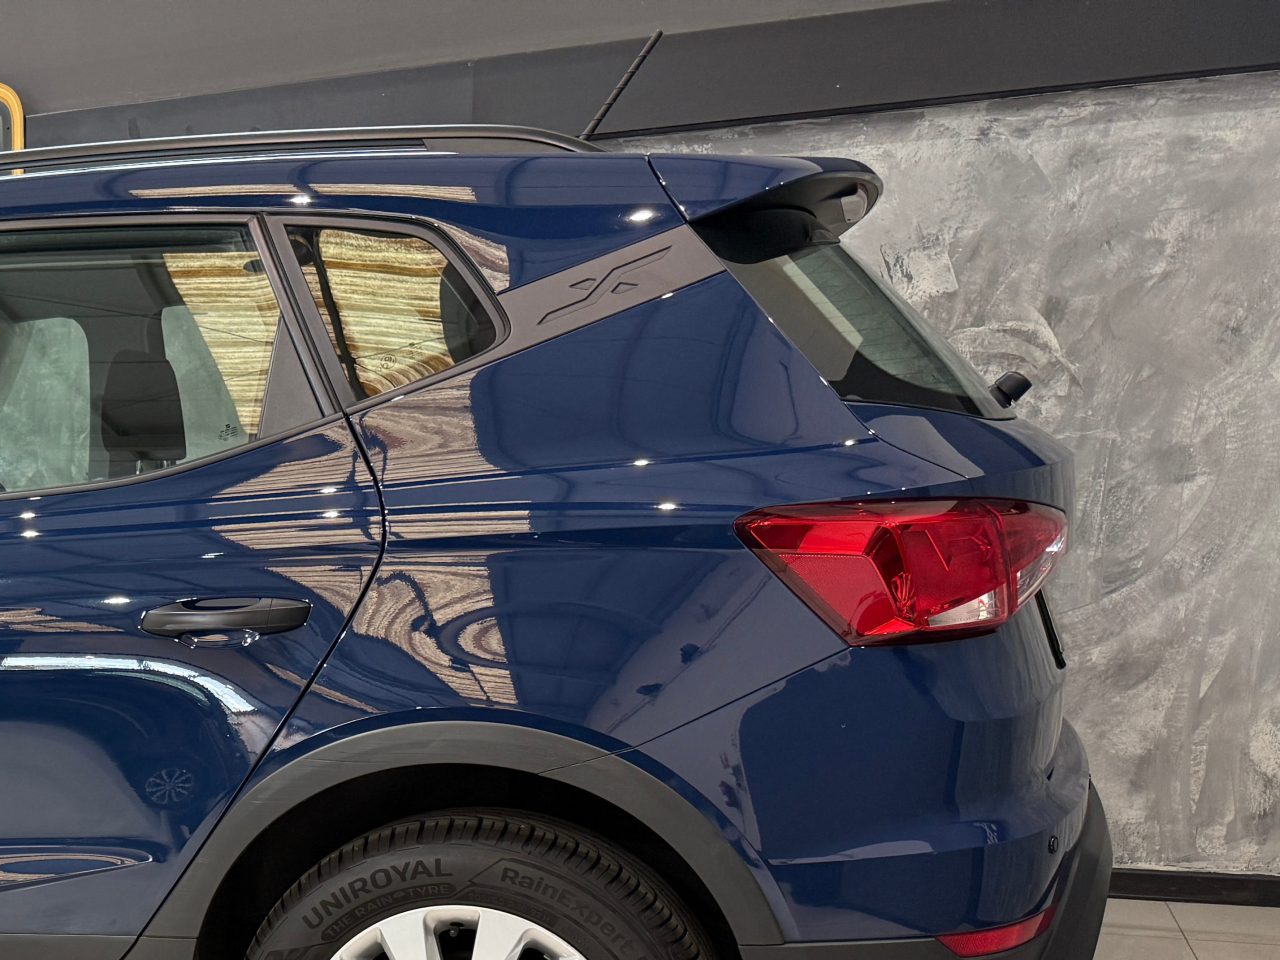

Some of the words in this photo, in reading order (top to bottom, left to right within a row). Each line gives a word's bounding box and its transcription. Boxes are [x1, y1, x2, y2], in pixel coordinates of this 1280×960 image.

[301, 858, 454, 930] UNIROYAL
[326, 914, 354, 938] THE
[355, 894, 393, 920] RAIN
[405, 883, 452, 898] TYRE
[500, 867, 634, 955] RainExpert
